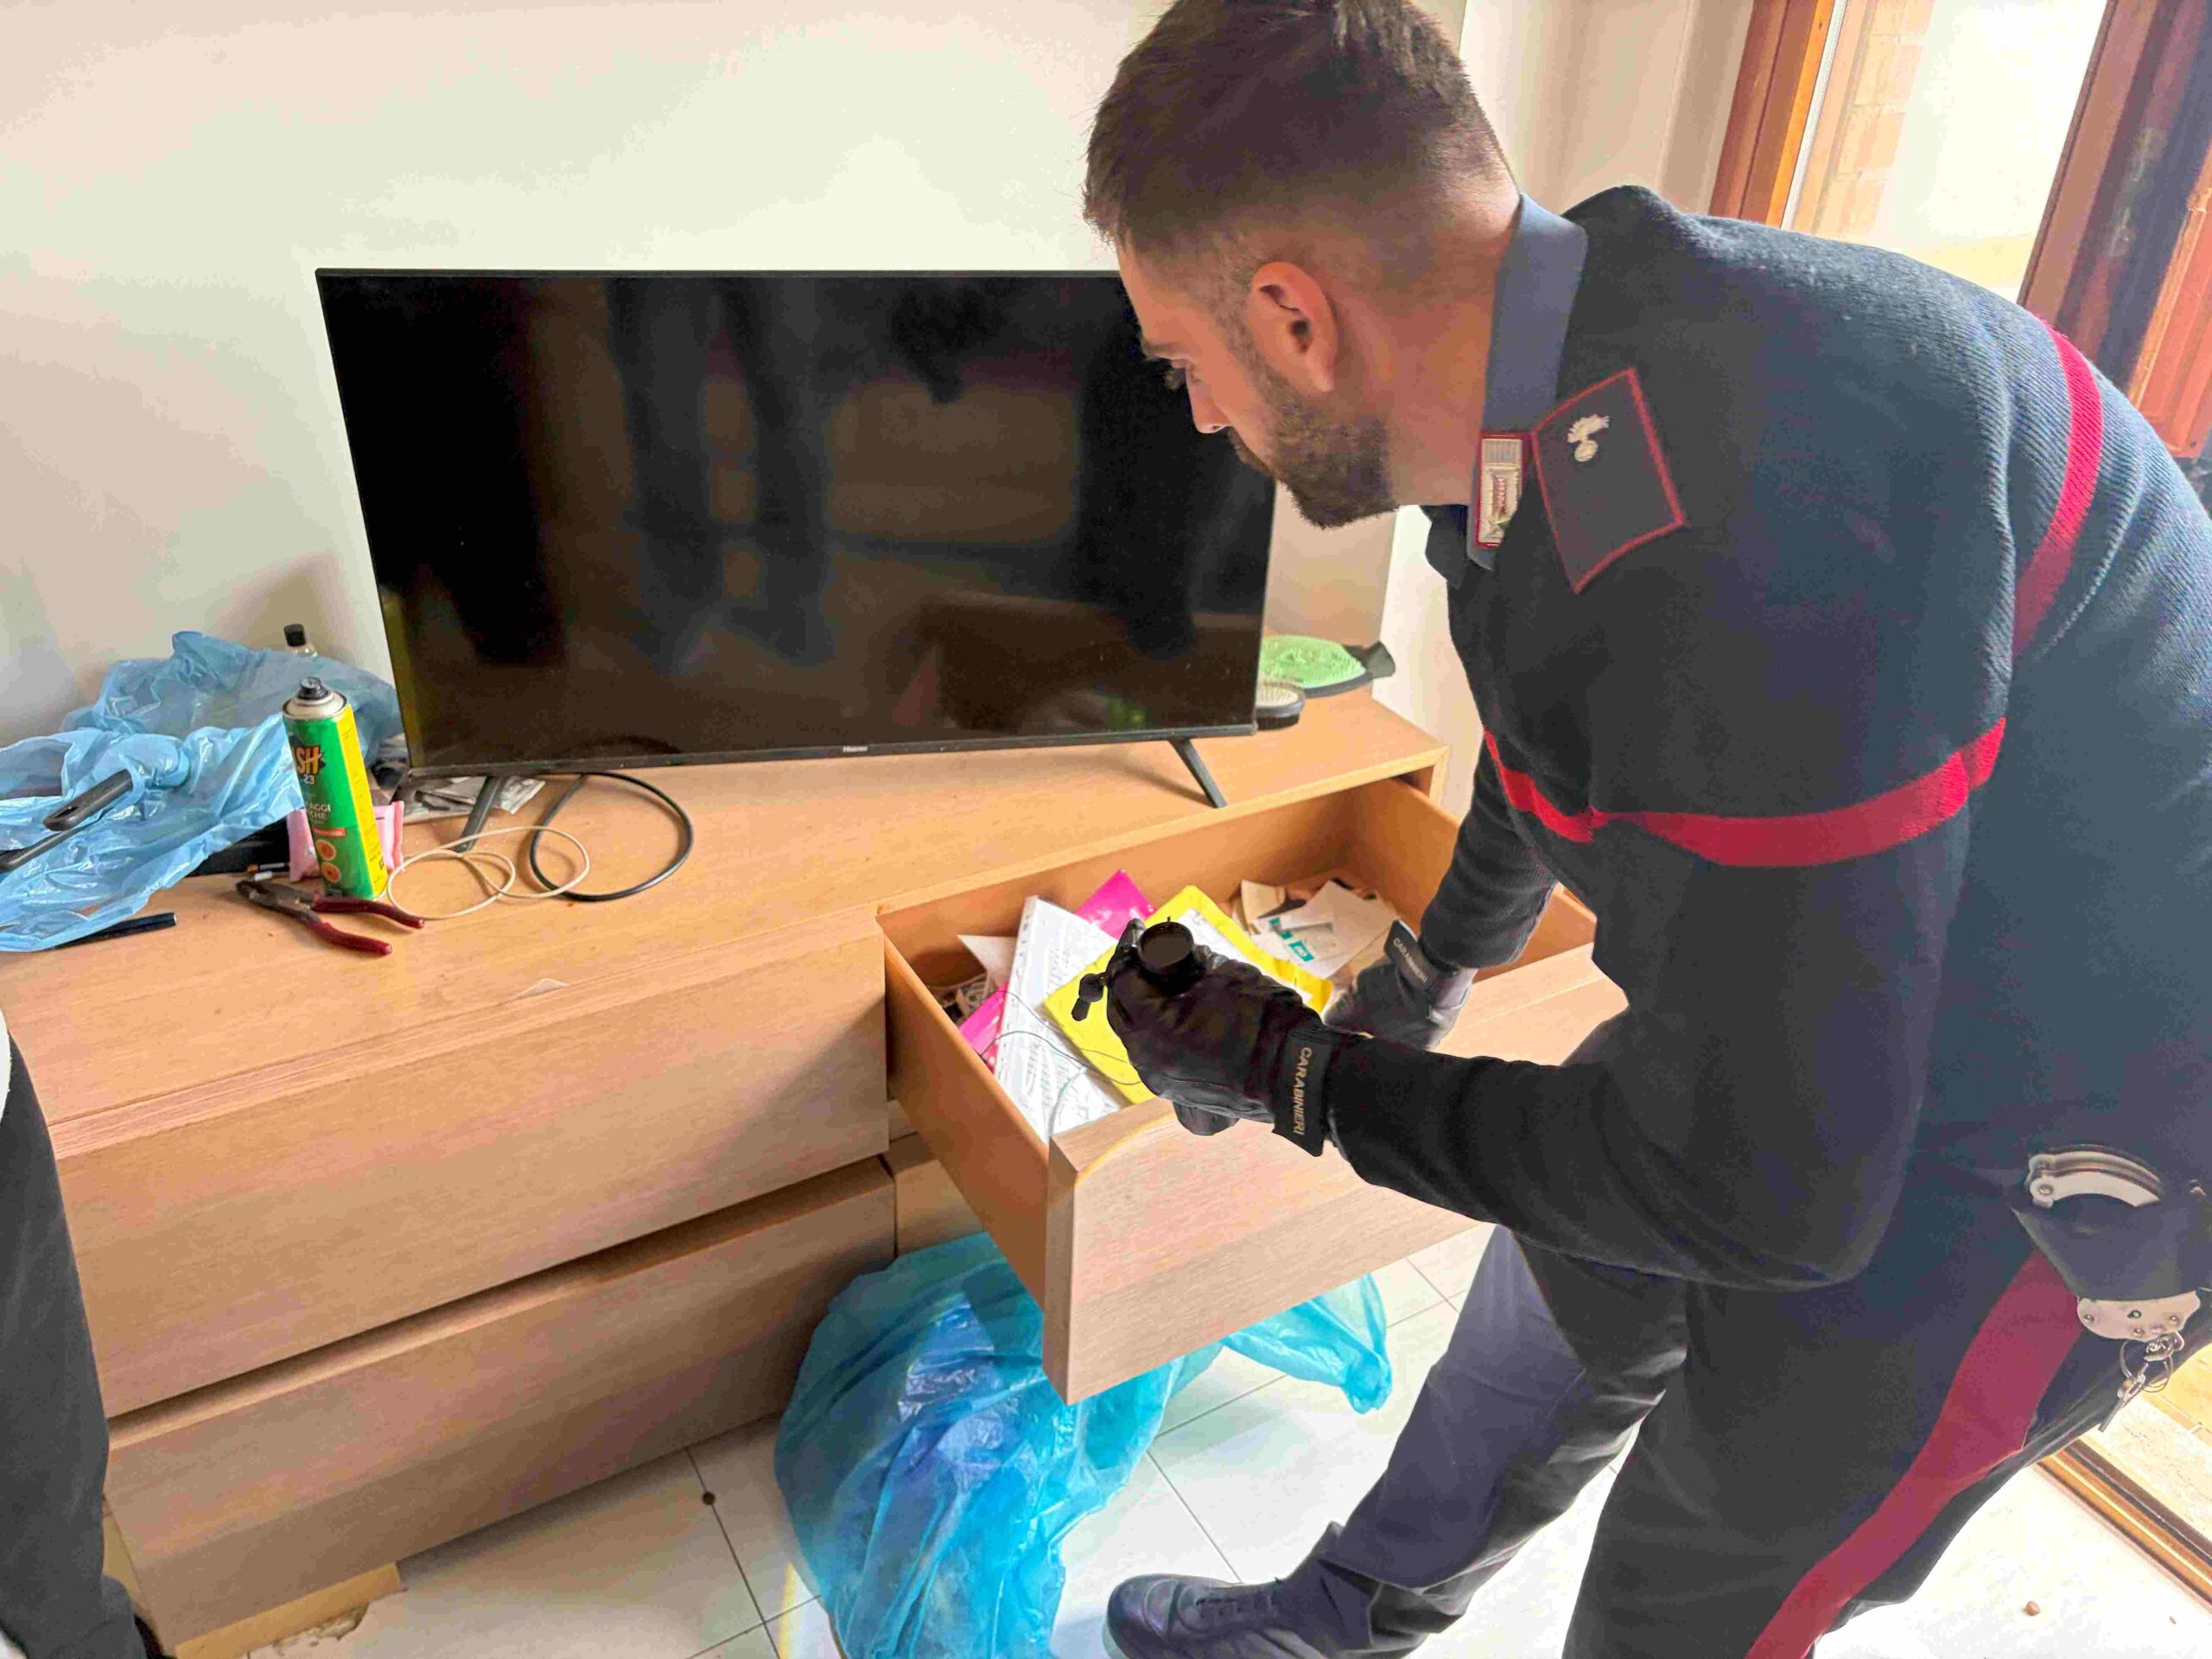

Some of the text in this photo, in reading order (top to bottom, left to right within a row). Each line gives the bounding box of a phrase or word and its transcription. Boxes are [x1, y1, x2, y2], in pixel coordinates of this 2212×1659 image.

[296, 746, 321, 774] SH
[308, 803, 331, 813] AGGI
[1293, 1046, 1313, 1135] CARABINIERI
